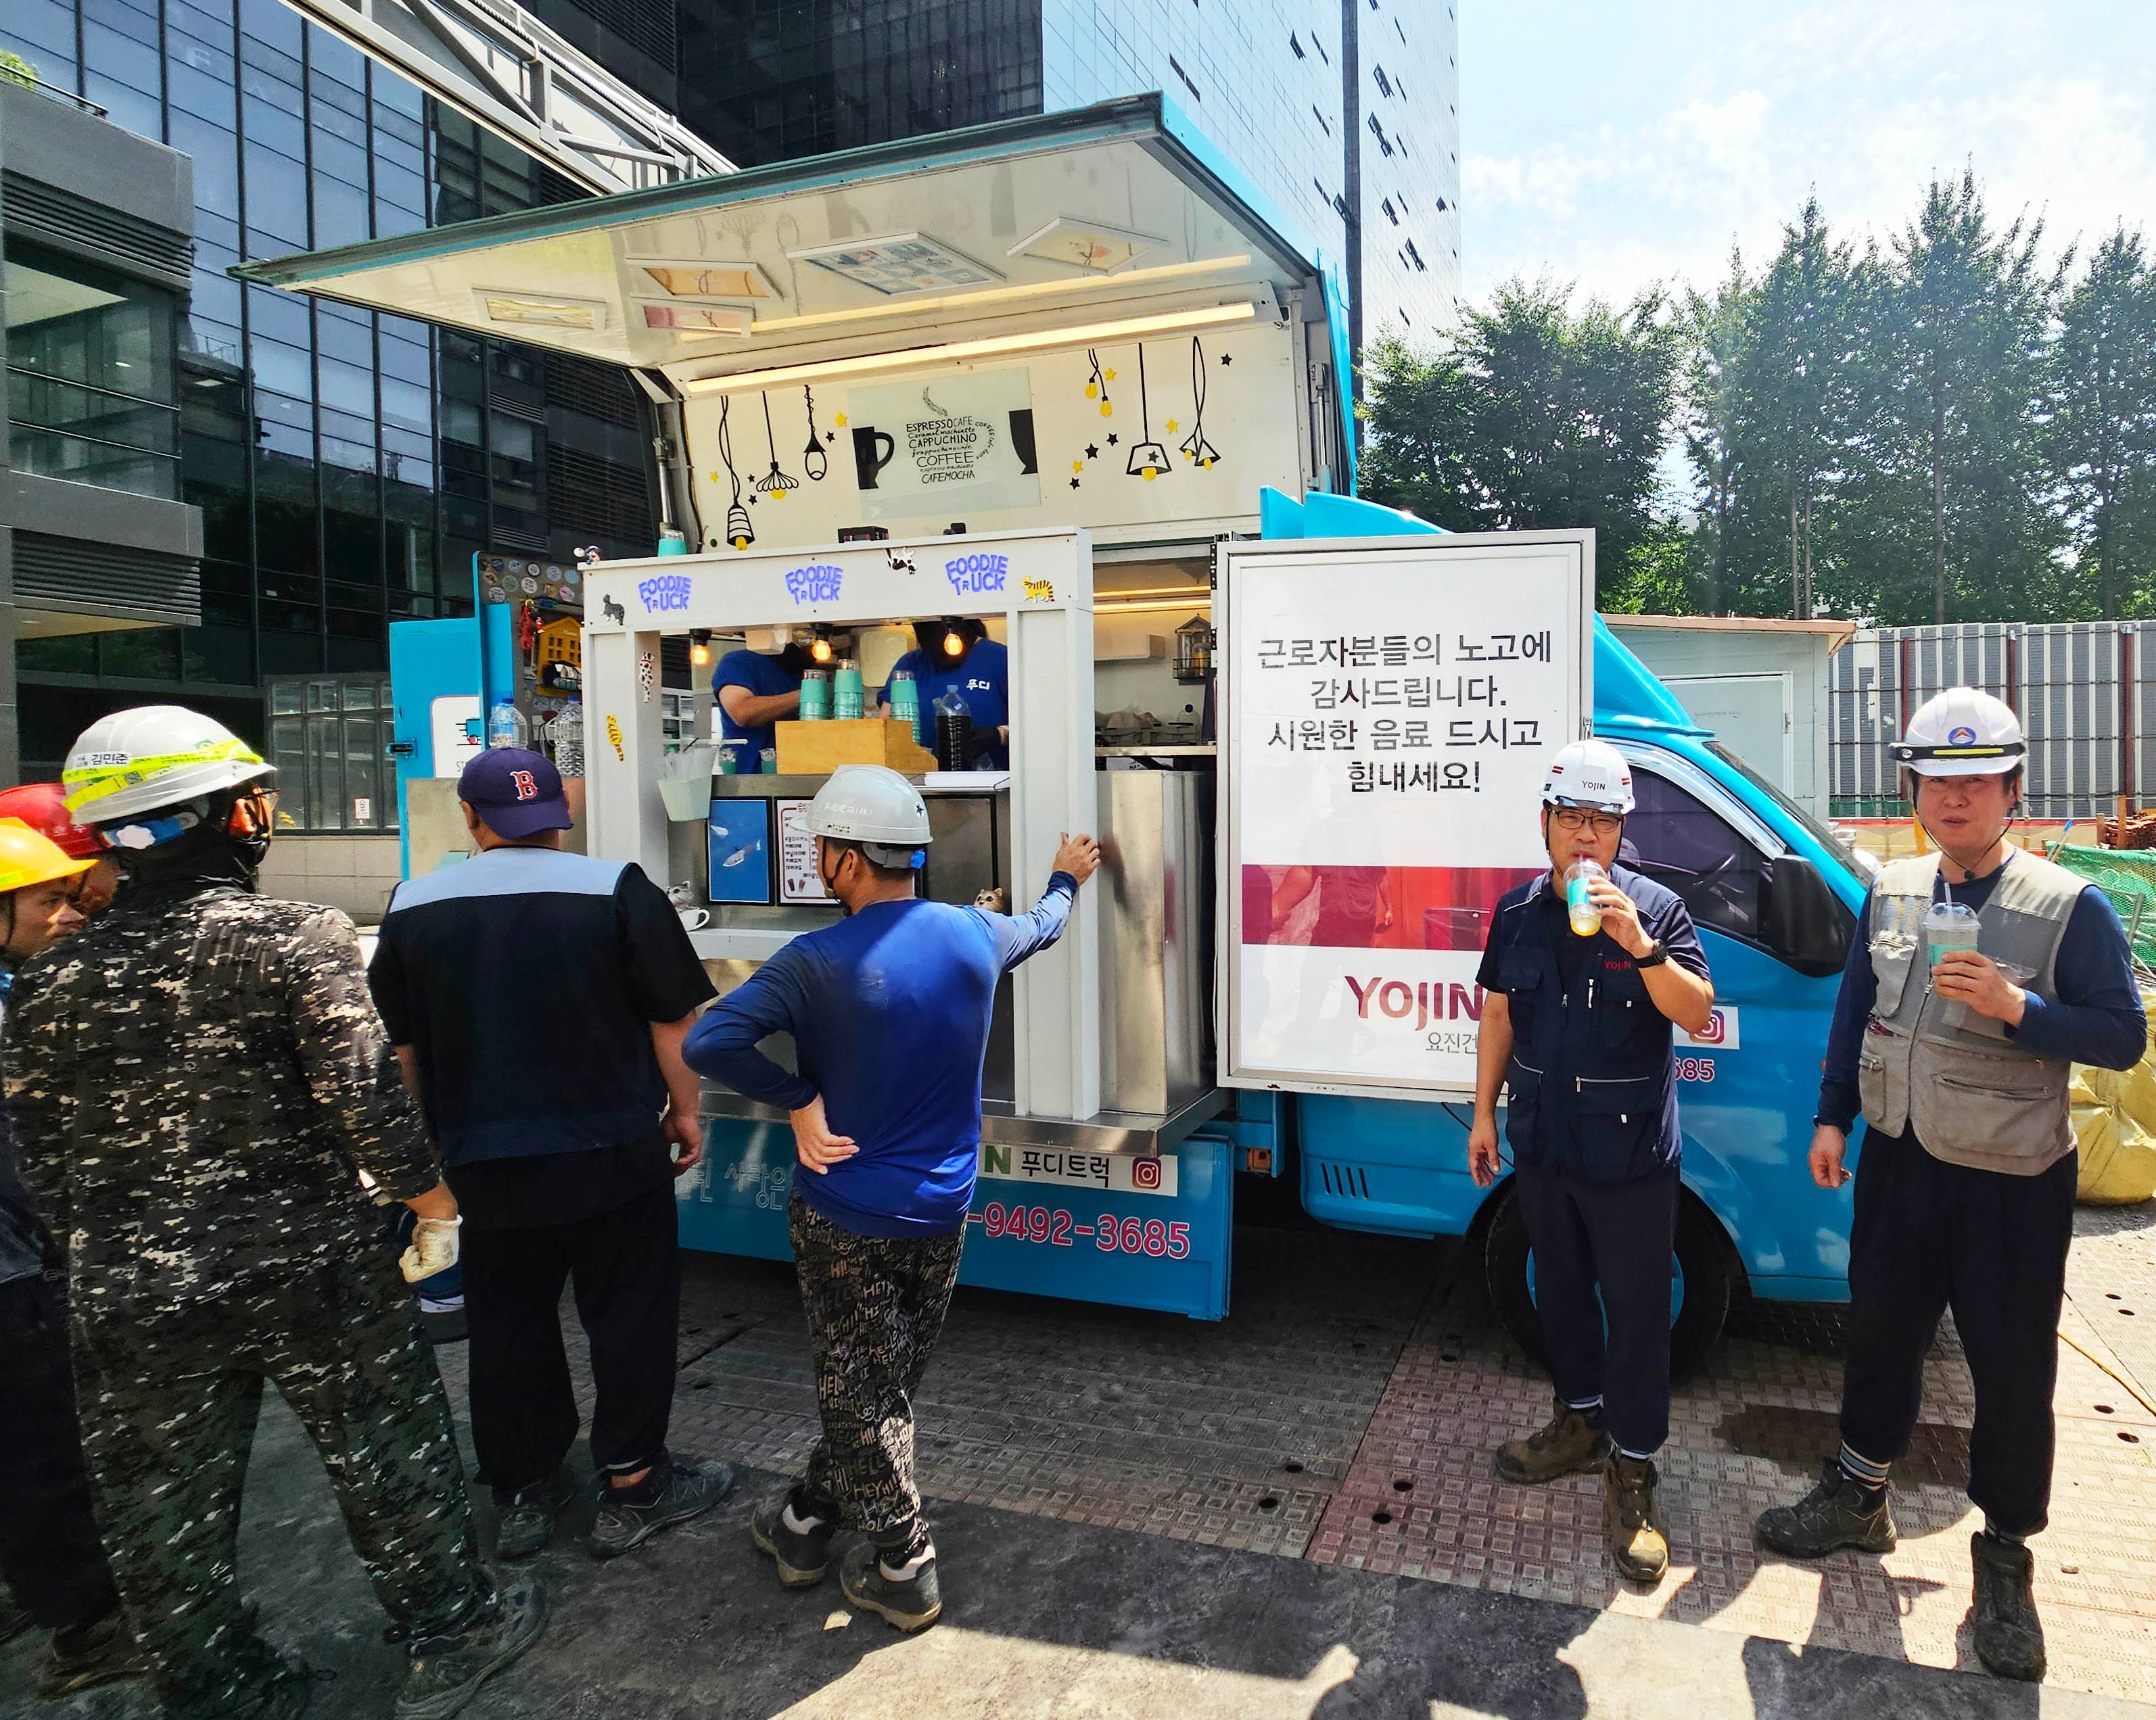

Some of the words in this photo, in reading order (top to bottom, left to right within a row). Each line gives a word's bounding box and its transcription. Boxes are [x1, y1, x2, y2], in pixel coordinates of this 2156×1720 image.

[906, 419, 953, 433] ESPRESSO
[954, 416, 972, 427] CAFE
[908, 432, 977, 449] CAPPUCHINO
[916, 451, 975, 467] COFFEE
[785, 565, 844, 592] FOODIE
[945, 553, 1009, 581] FOODIE
[638, 575, 693, 600] FOODIE
[791, 583, 840, 606] TRUCK
[951, 572, 1006, 596] TRUCK
[643, 594, 690, 614] TRUCK
[1257, 634, 1441, 669] 근로자분들의
[1455, 630, 1551, 663] 노고에
[966, 678, 990, 690] 푸디
[1311, 675, 1507, 709] 감사드립니다.
[1267, 719, 1359, 752] 시원한
[1370, 719, 1433, 751] 음료
[1445, 717, 1543, 750] 드시고
[509, 770, 538, 801] B
[1347, 761, 1481, 792] 힘내세요!
[1581, 780, 1606, 791] YOJIN
[1603, 961, 1632, 970] YOJIN
[1344, 975, 1484, 1031] YOJIN
[1021, 1151, 1110, 1189] 푸디트럭
